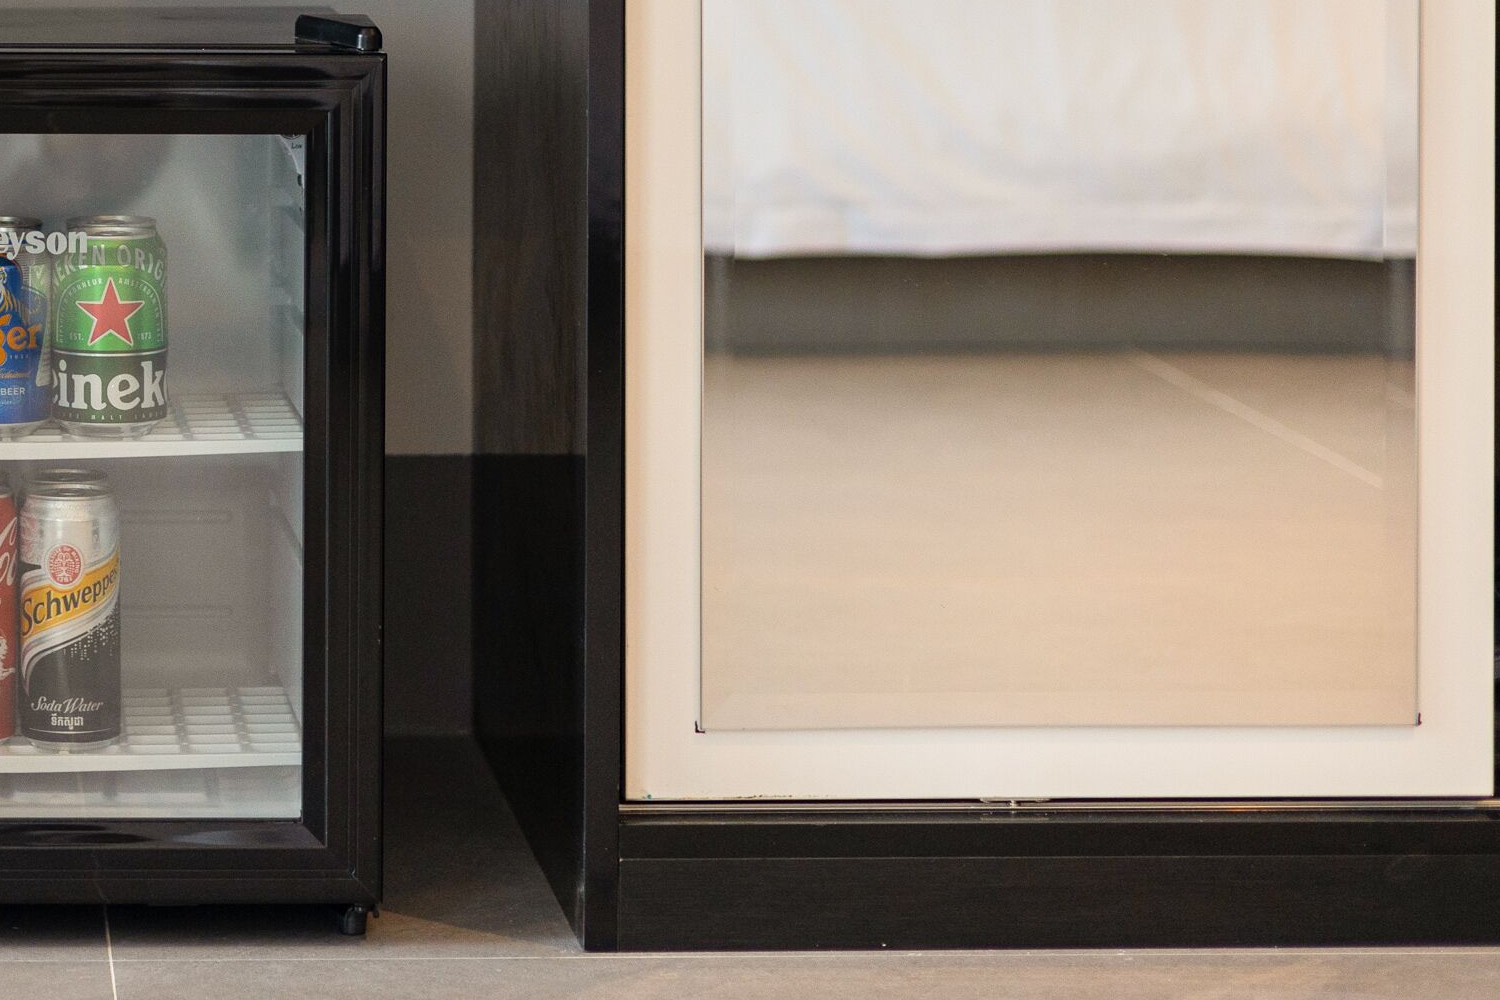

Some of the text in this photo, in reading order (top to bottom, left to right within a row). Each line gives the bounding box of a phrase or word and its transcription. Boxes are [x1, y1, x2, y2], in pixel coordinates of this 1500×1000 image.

[0, 387, 26, 396] BEER
[31, 695, 104, 713] Soda Water
